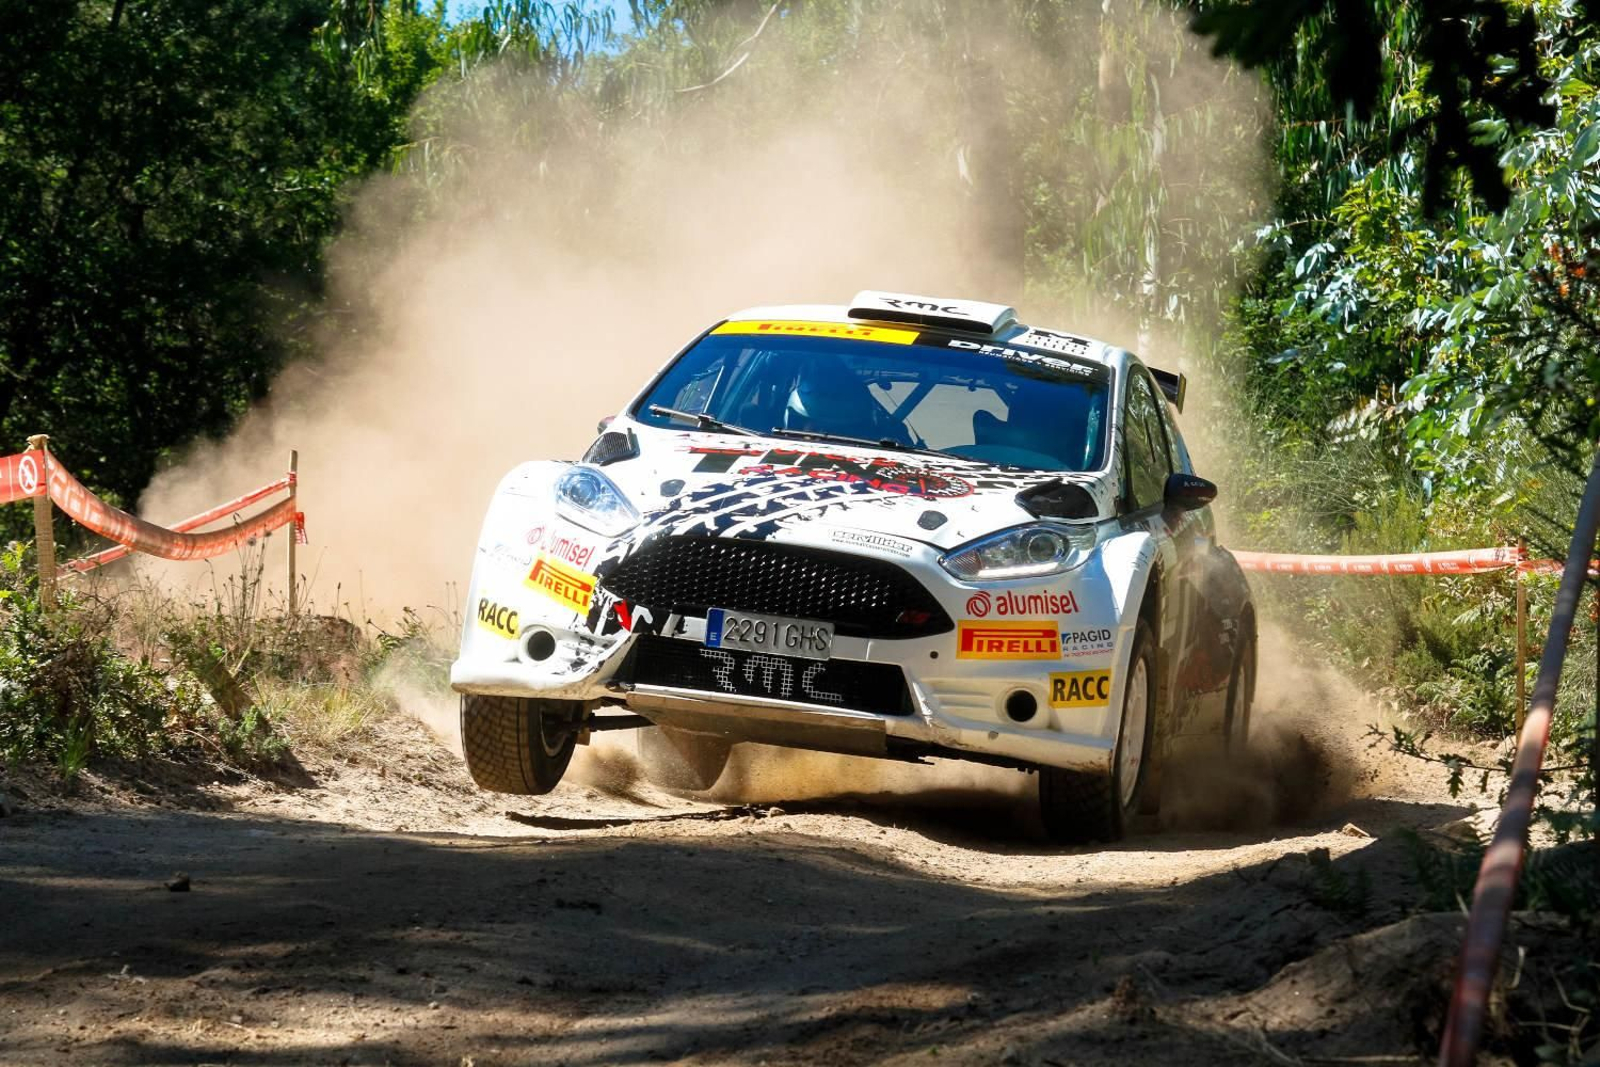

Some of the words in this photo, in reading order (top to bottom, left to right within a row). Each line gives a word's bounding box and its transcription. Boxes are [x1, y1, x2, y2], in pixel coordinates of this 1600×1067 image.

[529, 559, 593, 607] PIRELLI
[995, 590, 1080, 615] alumisel
[478, 597, 519, 635] RACC
[961, 628, 1058, 653] PIRELLI
[1072, 629, 1112, 643] PAGID
[1052, 676, 1109, 702] RACC
